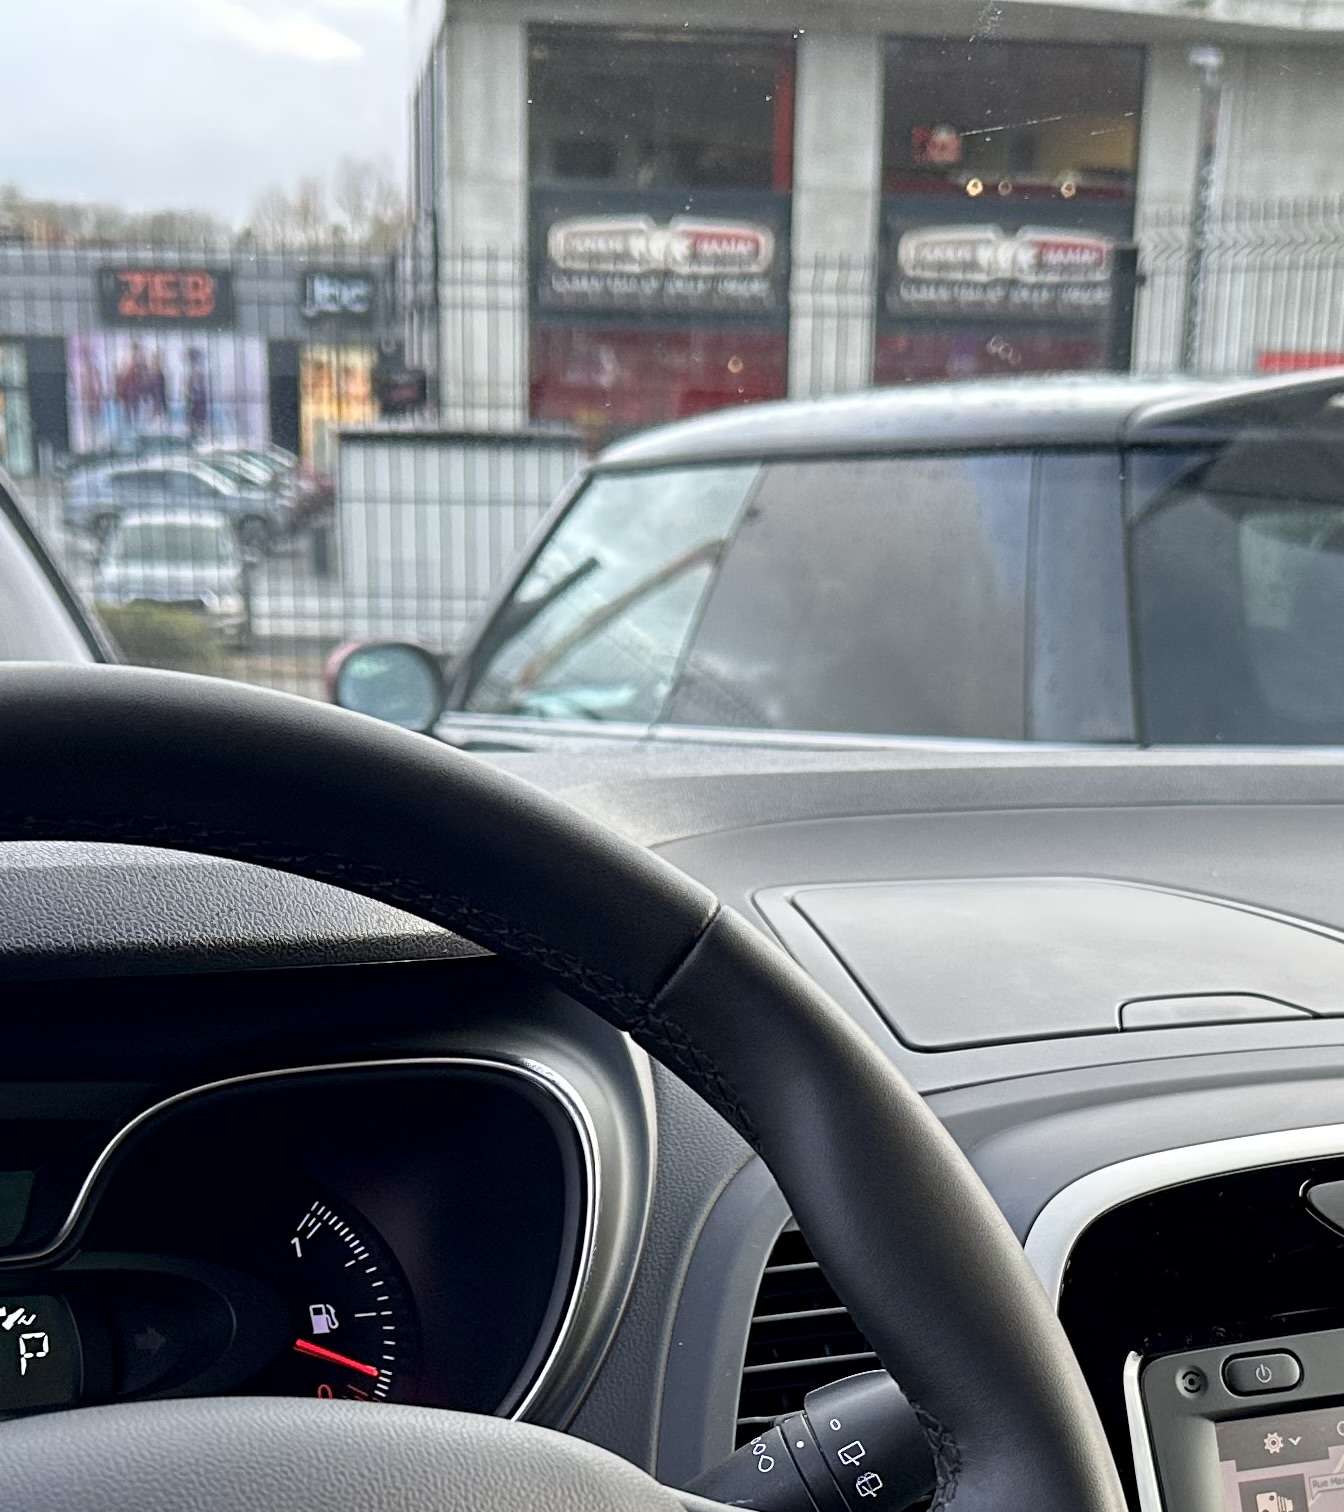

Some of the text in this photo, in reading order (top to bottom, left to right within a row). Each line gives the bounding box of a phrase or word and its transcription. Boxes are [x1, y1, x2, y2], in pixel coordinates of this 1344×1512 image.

[117, 268, 216, 318] ZEB
[291, 1236, 302, 1258] 1
[19, 1331, 49, 1376] P
